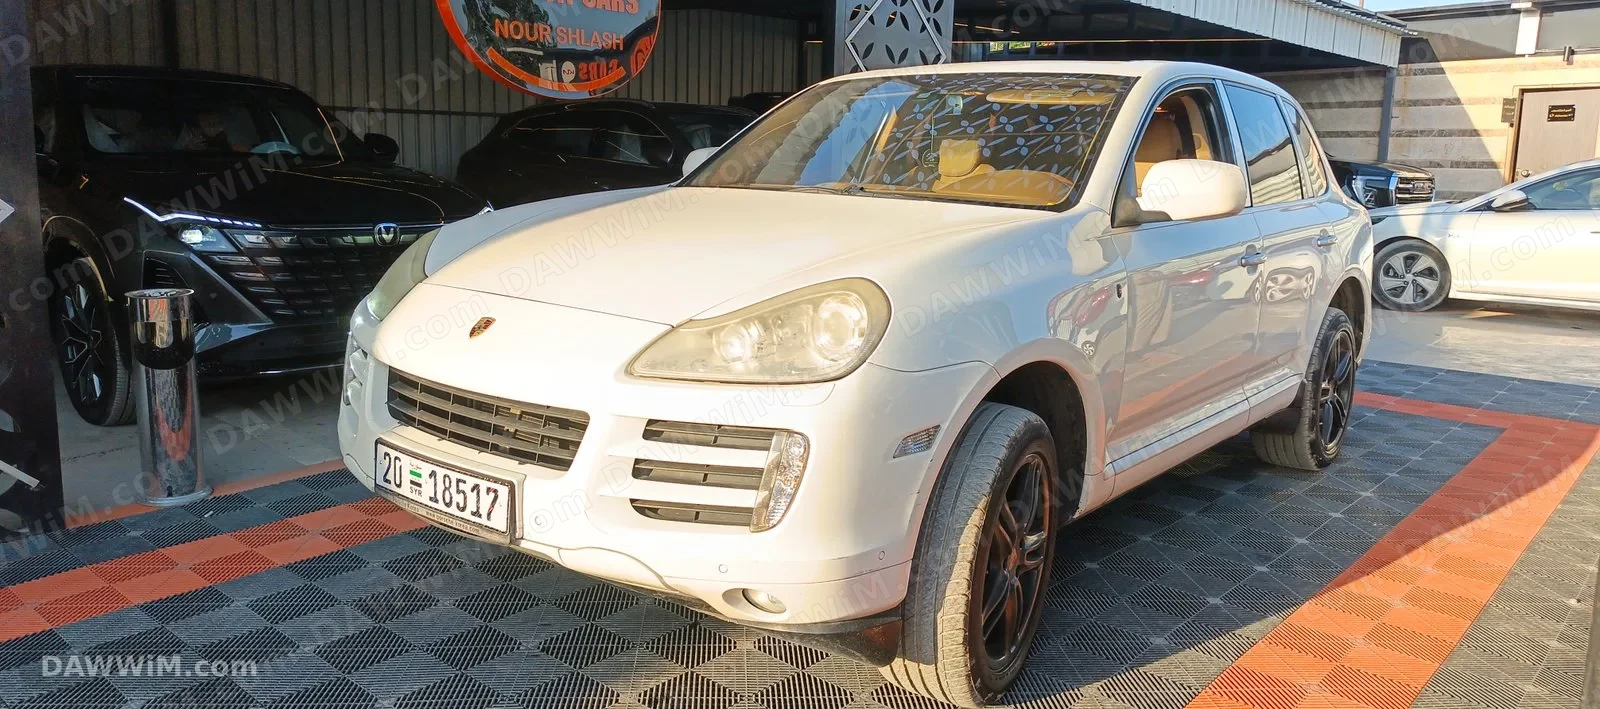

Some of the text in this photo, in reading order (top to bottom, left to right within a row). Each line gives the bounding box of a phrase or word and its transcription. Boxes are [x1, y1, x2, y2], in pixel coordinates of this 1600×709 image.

[494, 18, 624, 50] NOUR SHLASH
[382, 451, 499, 522] 20 18517
[409, 486, 423, 498] SYR
